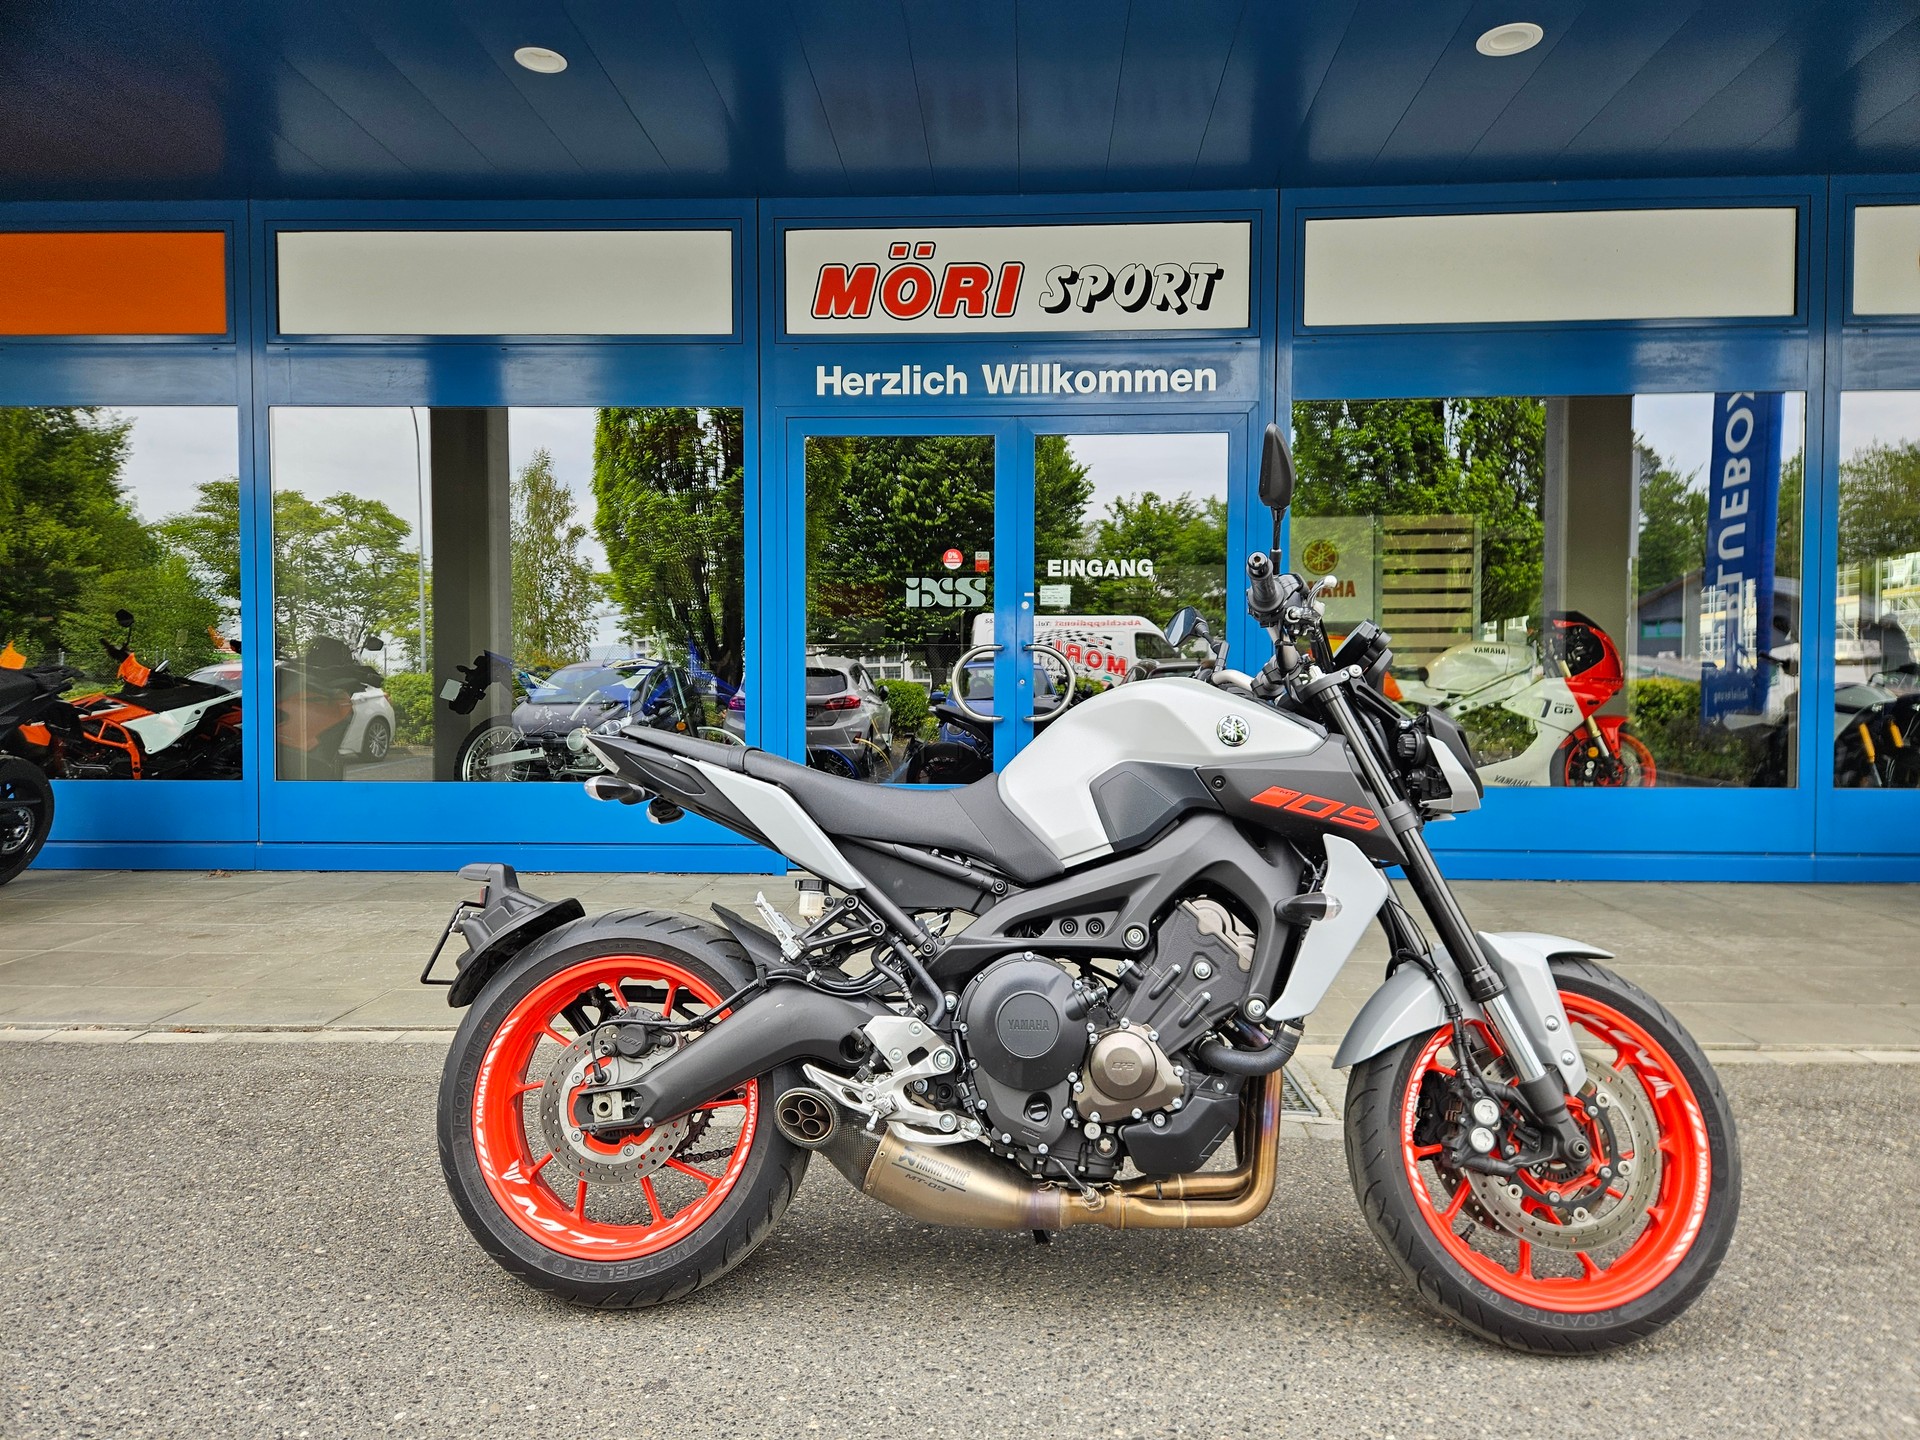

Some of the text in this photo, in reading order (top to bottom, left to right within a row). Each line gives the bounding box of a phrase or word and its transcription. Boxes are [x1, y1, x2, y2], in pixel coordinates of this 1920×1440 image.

[811, 241, 1225, 321] MÖRI SPORT
[816, 363, 1217, 396] Herzlich Willkommen
[1047, 559, 1154, 577] EINGANG
[1473, 646, 1506, 655] YAMAHA
[1008, 1019, 1049, 1031] YAMAHA
[476, 1066, 491, 1125] YAMAHA
[744, 1084, 756, 1143] YAMAHA
[1404, 1082, 1419, 1142] YAMAHA
[904, 1172, 947, 1192] MT-09
[1693, 1151, 1708, 1215] YAMAHA
